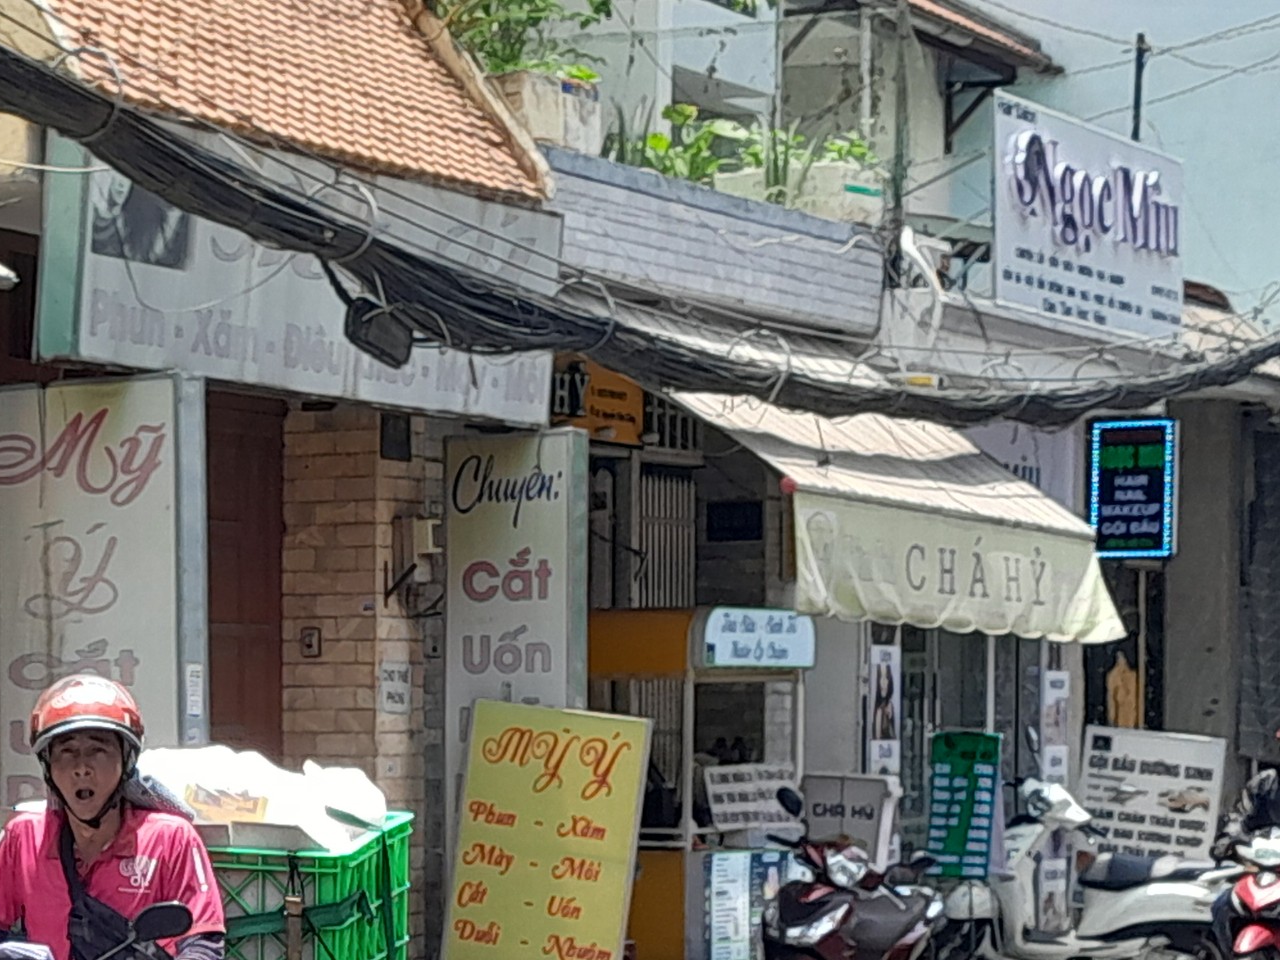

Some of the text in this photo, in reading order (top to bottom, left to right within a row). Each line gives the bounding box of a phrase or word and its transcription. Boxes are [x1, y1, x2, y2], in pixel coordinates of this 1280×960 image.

[451, 454, 563, 529] Chuyên:
[461, 546, 553, 603] Cắt
[462, 624, 553, 675] Uốn
